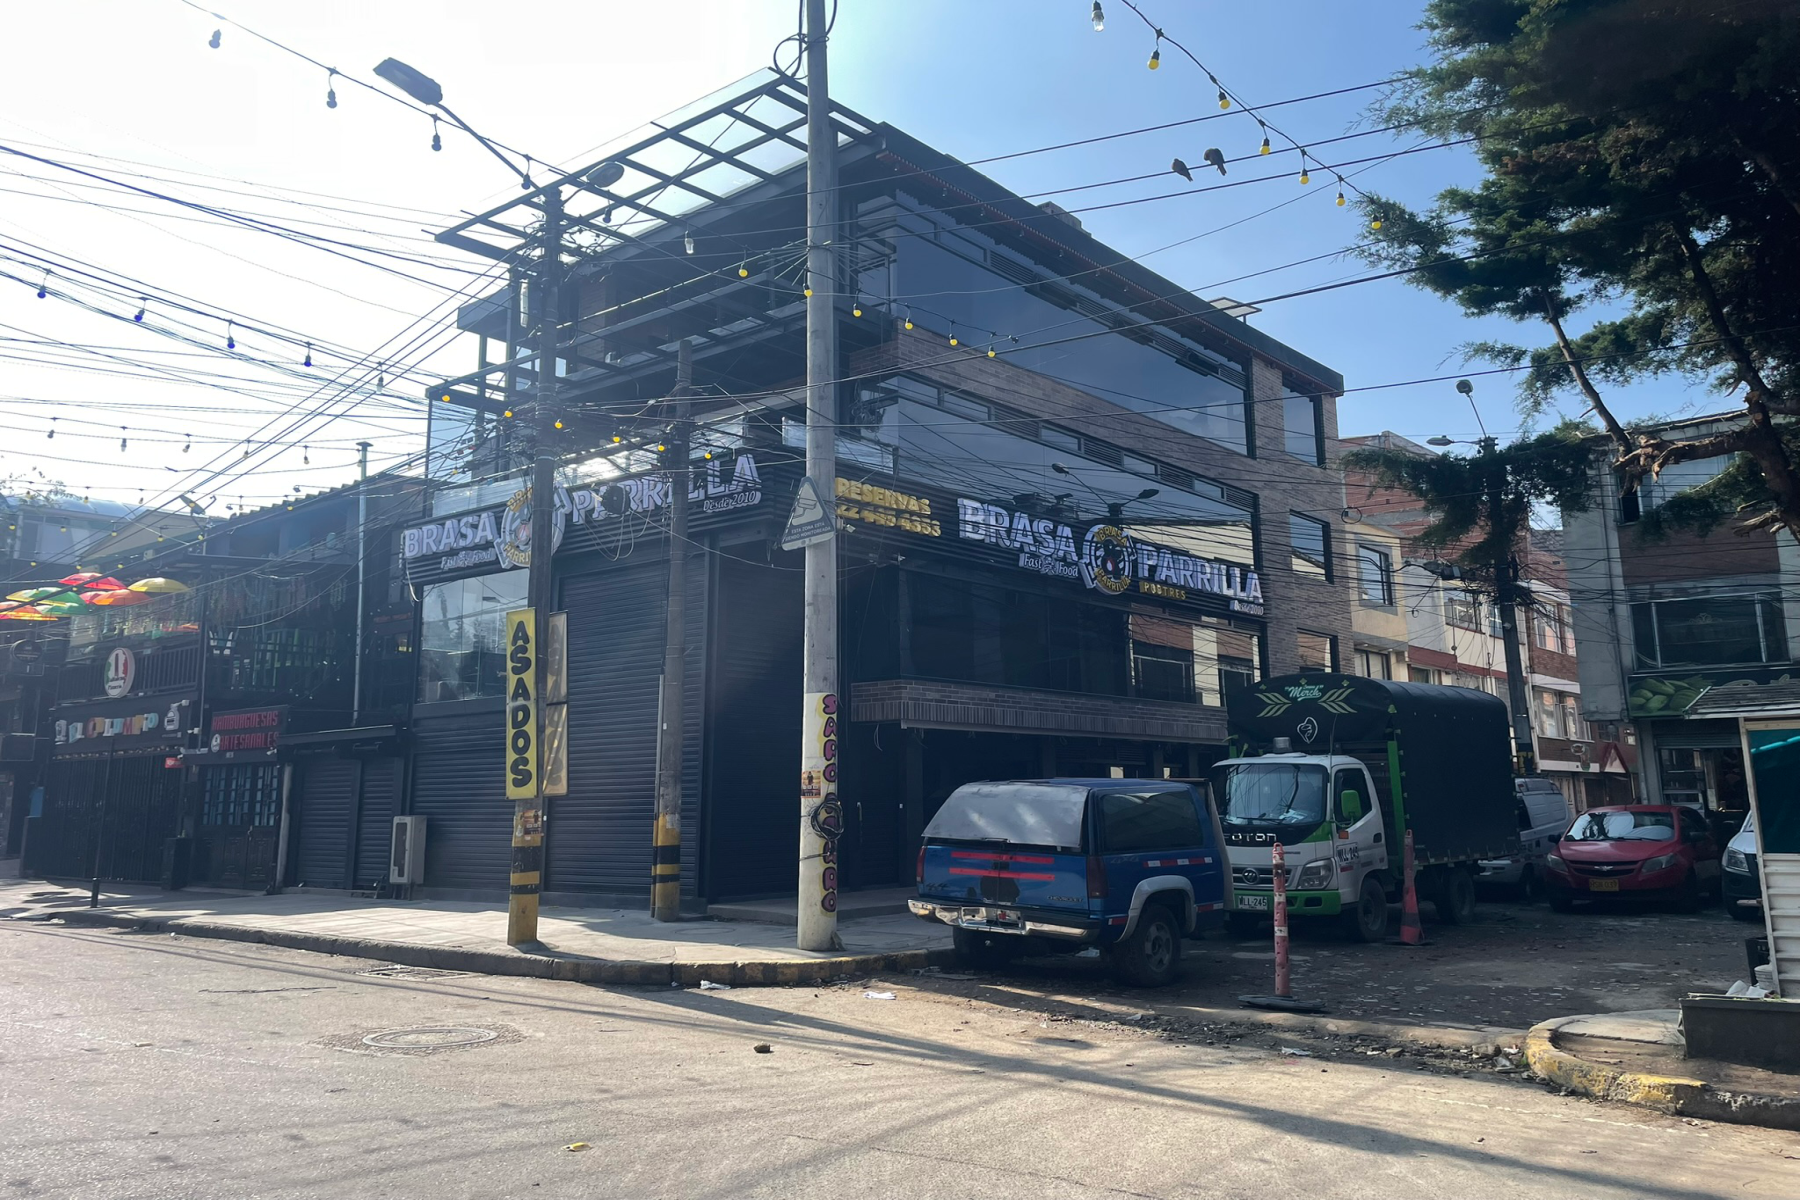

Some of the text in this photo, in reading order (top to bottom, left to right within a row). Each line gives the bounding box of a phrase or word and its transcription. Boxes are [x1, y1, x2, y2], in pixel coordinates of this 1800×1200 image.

[703, 491, 758, 512] Desde 2010
[836, 477, 931, 514] RESERVAS
[404, 512, 498, 557] BRASA
[958, 498, 1078, 563] BRASA
[1097, 525, 1127, 546] BRASA
[1022, 553, 1079, 577] Fast Food
[1136, 543, 1263, 603] PARRILLA
[1097, 568, 1131, 591] PARRILLA
[510, 620, 532, 788] ASADOS
[212, 711, 278, 730] HAMBURGUESAS
[221, 731, 279, 750] ARTESANALES
